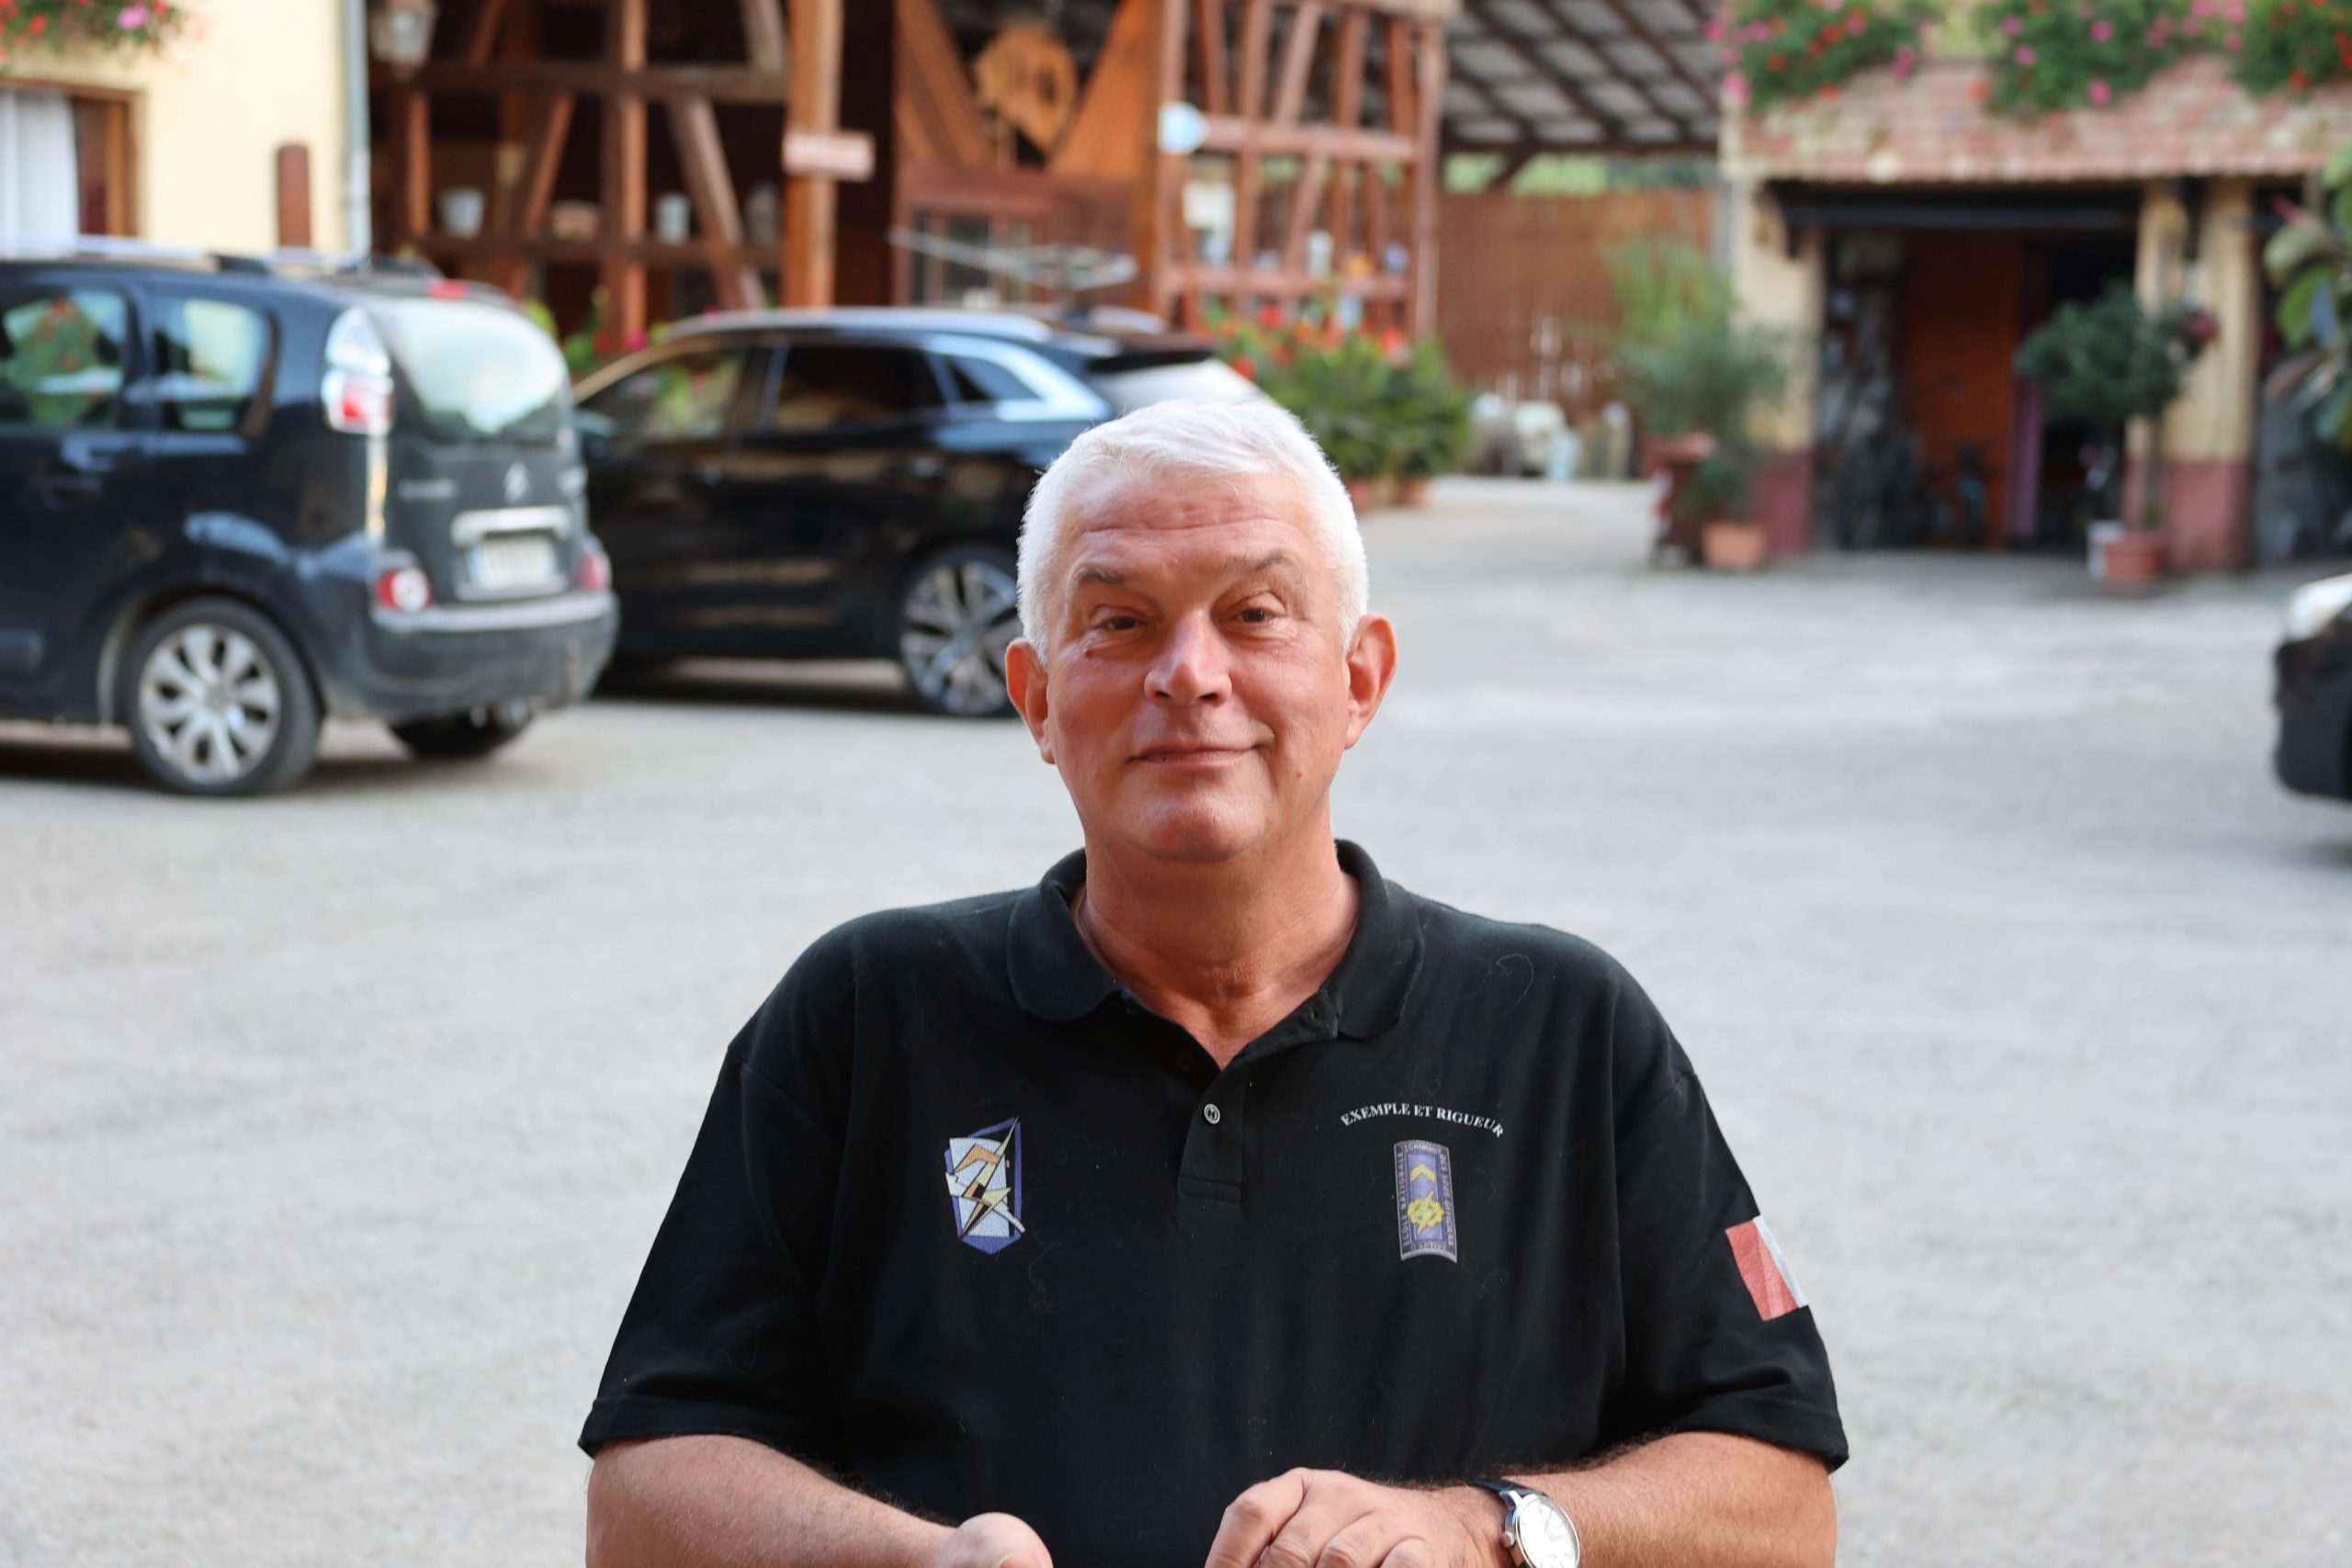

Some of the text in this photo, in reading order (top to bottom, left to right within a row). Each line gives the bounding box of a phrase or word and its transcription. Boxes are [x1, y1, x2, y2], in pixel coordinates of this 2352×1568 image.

[1340, 1103, 1504, 1138] EXEMPLE ET RIGUEUR
[1397, 1153, 1407, 1211] NATIONALE
